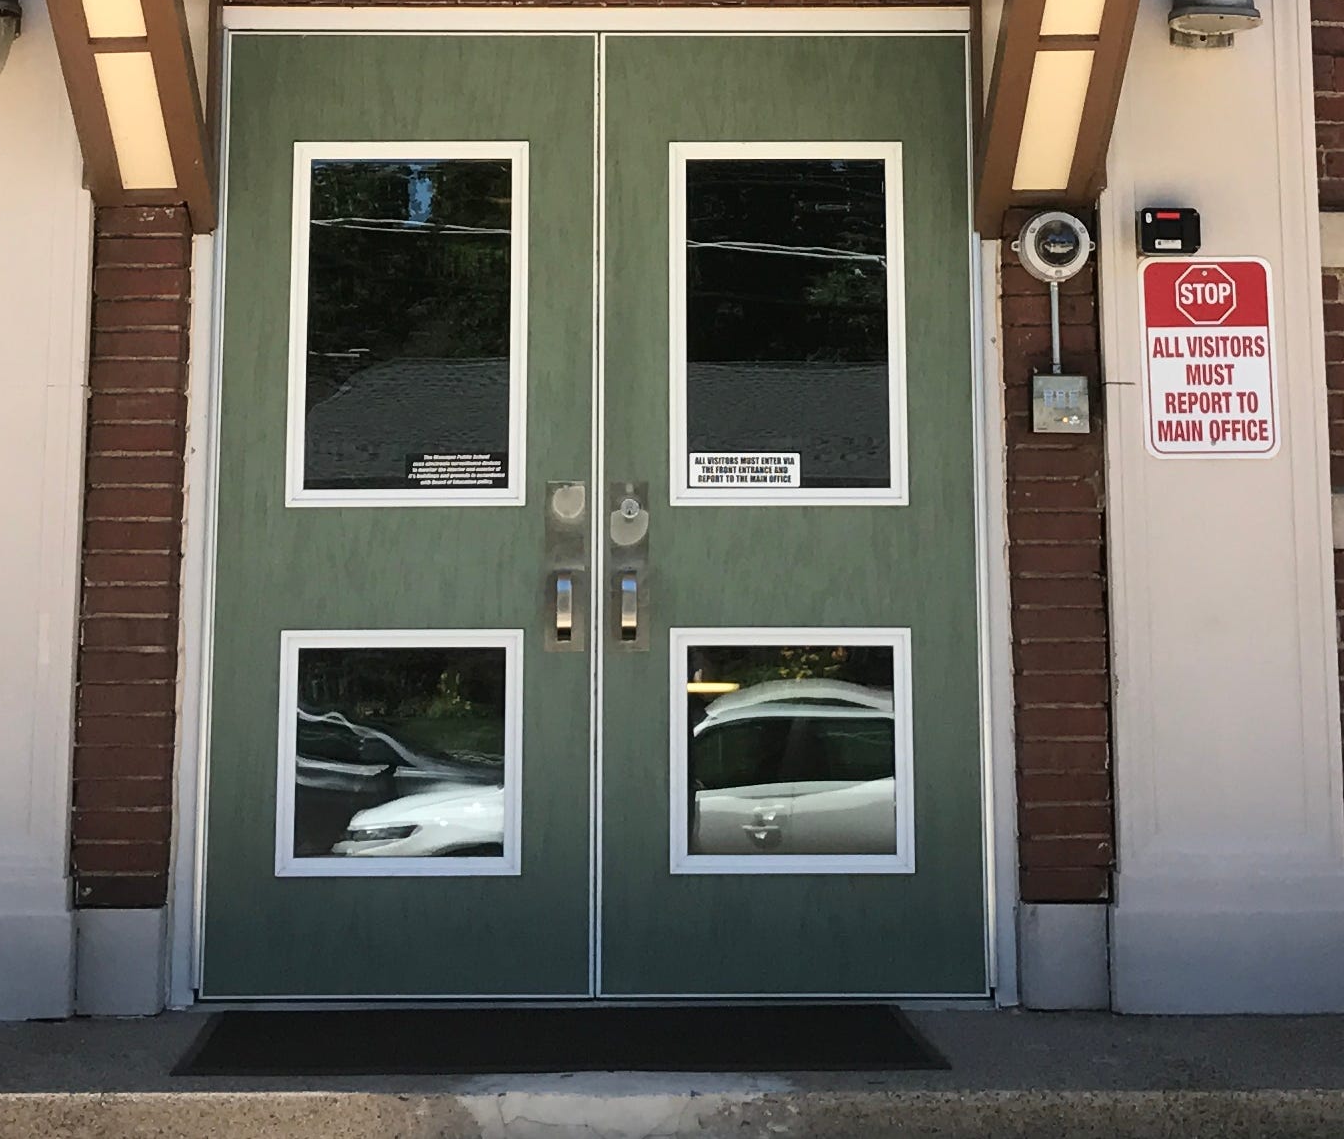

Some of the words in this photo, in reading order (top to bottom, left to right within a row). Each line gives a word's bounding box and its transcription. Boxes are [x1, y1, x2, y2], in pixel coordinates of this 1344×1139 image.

[1180, 282, 1231, 305] STOP
[1152, 336, 1185, 359] ALL
[1186, 335, 1266, 358] VISITORS
[1185, 363, 1235, 386] MUST
[1165, 391, 1233, 414] REPORT
[1237, 391, 1259, 414] TO
[1157, 419, 1204, 443] MAIN
[1209, 419, 1269, 442] OFFICE
